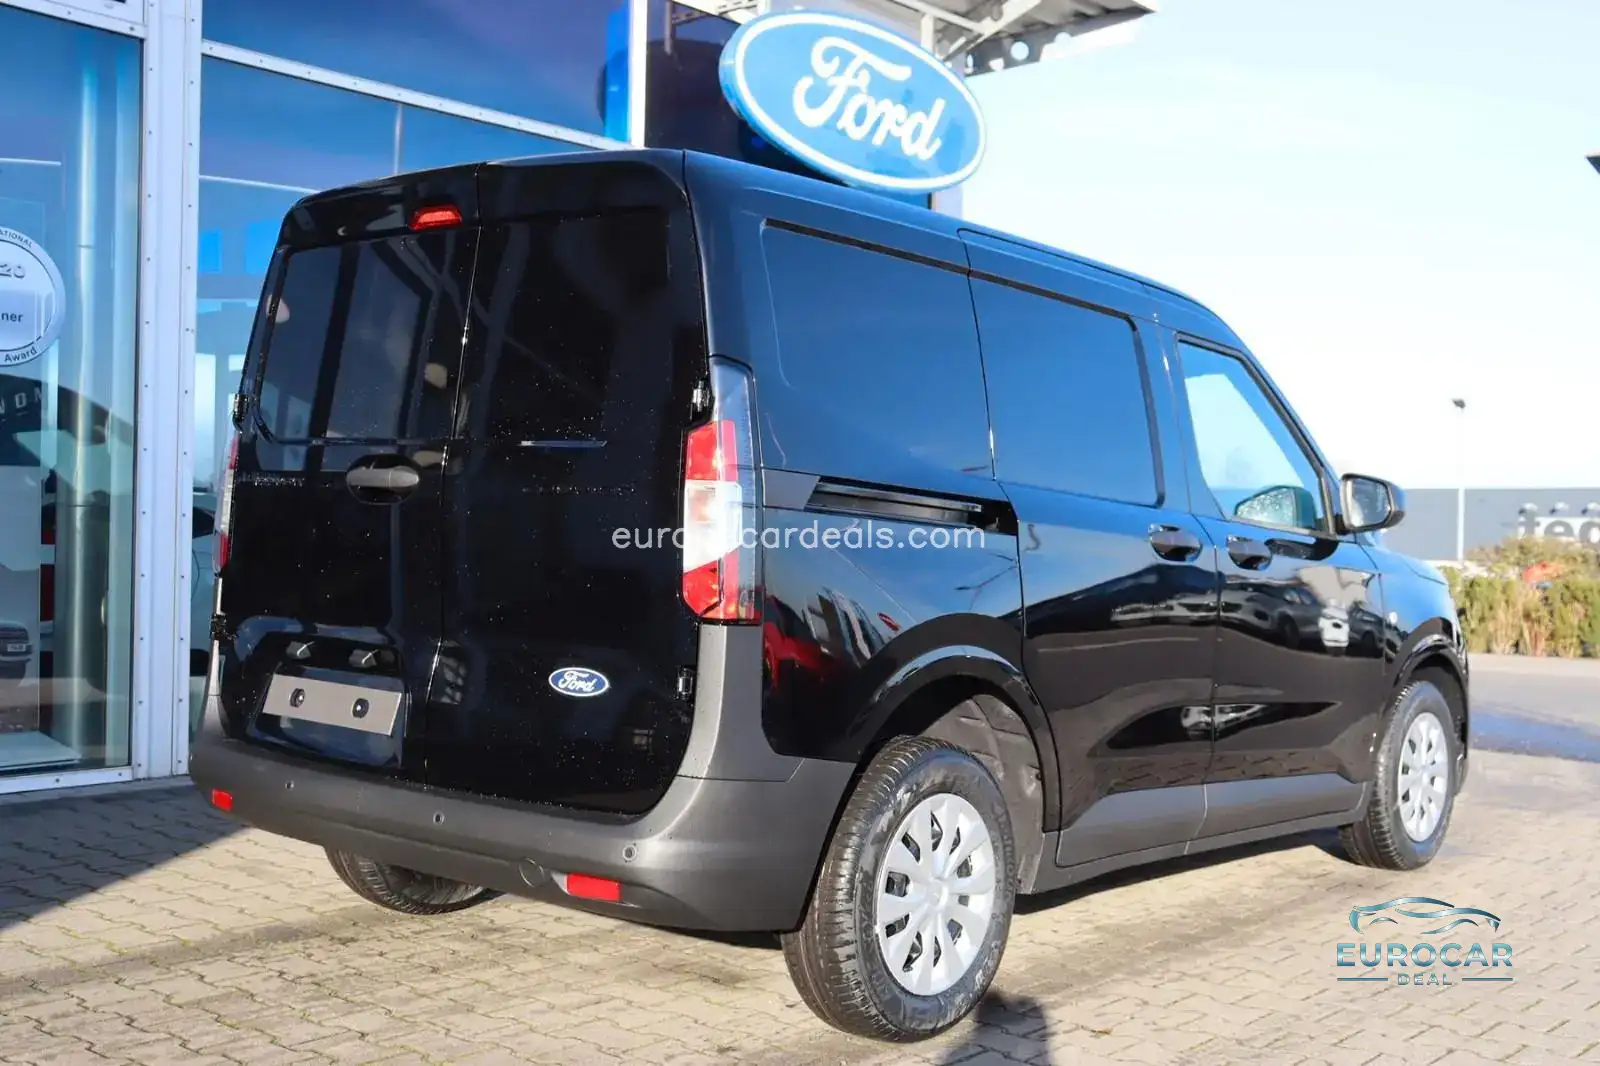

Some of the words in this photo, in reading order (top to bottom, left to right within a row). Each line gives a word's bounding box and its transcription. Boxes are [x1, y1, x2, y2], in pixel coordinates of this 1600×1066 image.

[792, 36, 946, 160] Ford
[4, 345, 38, 362] Award
[558, 670, 598, 692] Ford
